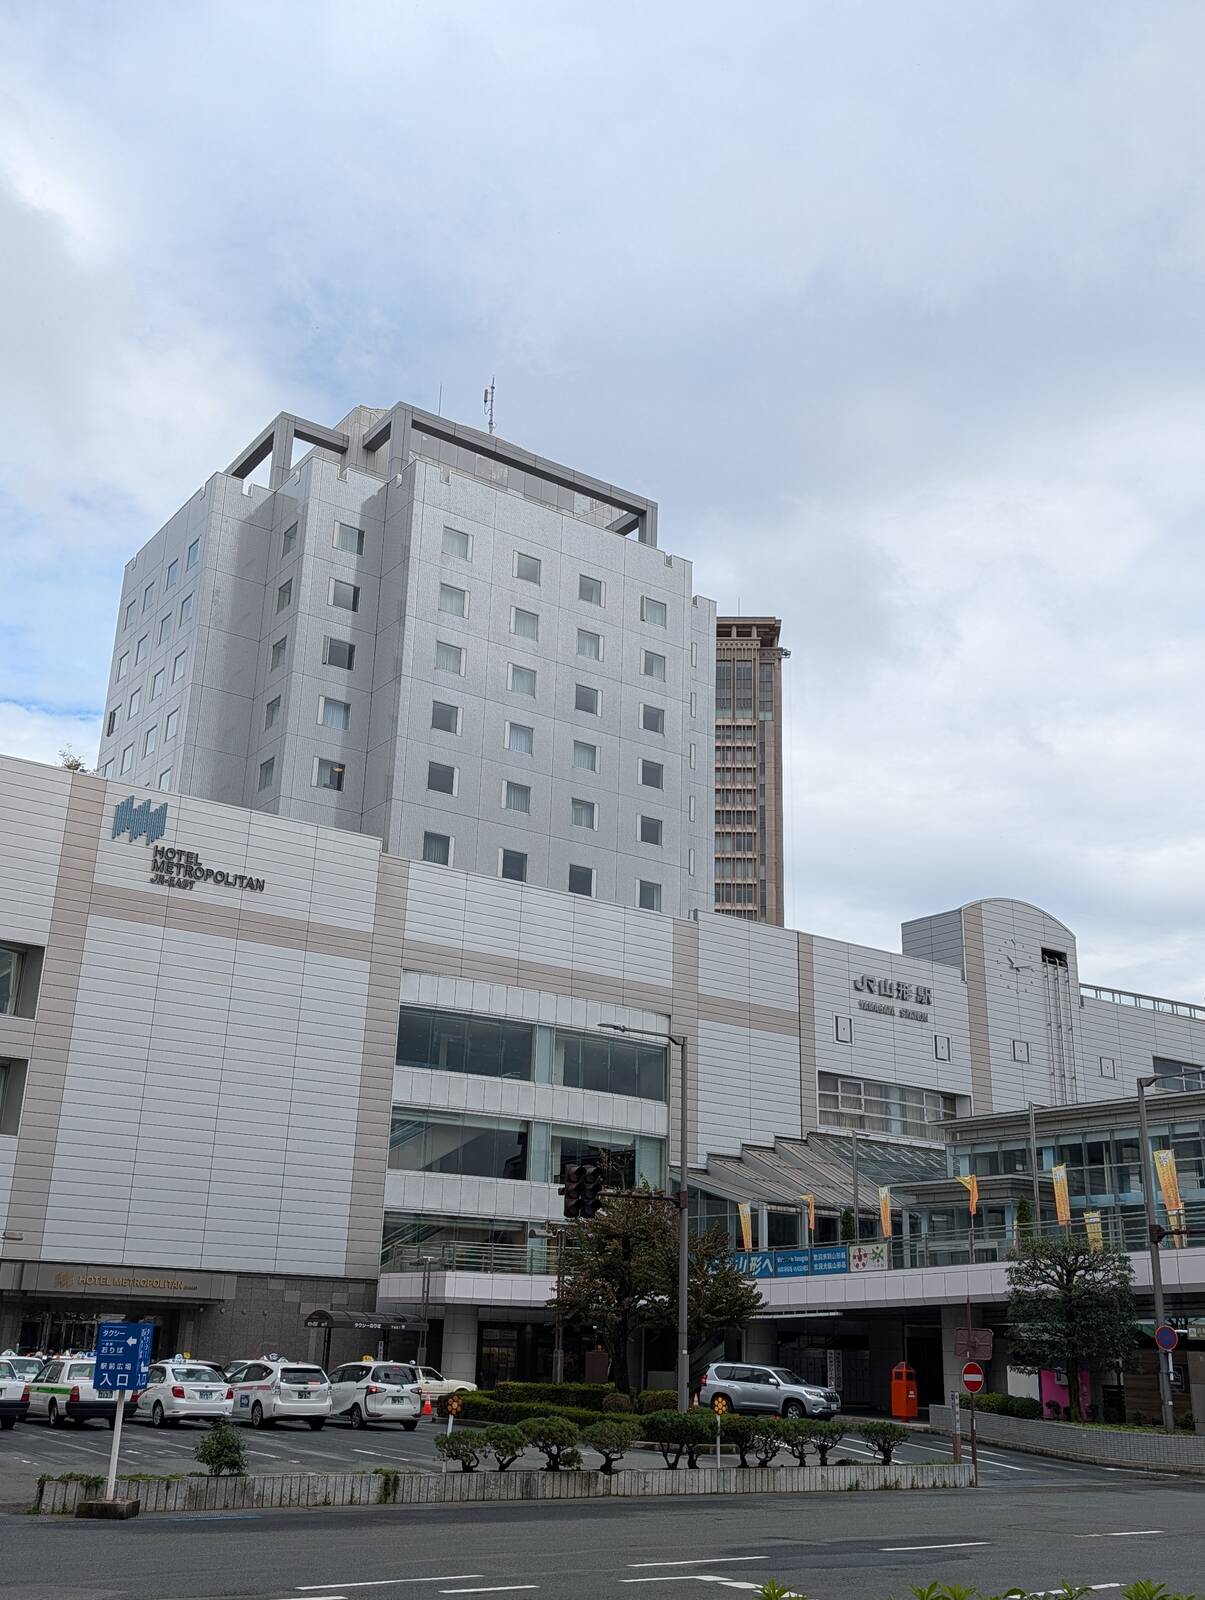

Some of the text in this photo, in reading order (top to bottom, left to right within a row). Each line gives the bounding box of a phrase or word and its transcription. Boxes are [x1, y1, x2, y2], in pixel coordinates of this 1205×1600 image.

[153, 845, 202, 866] HOTEL
[151, 873, 195, 890] JR-EAST
[152, 859, 265, 891] METROPOLITAN
[79, 1275, 111, 1287] HOTEL
[112, 1278, 184, 1290] METROPOLITAN
[100, 1362, 132, 1370] 駅前広場
[100, 1373, 129, 1386] 入口
